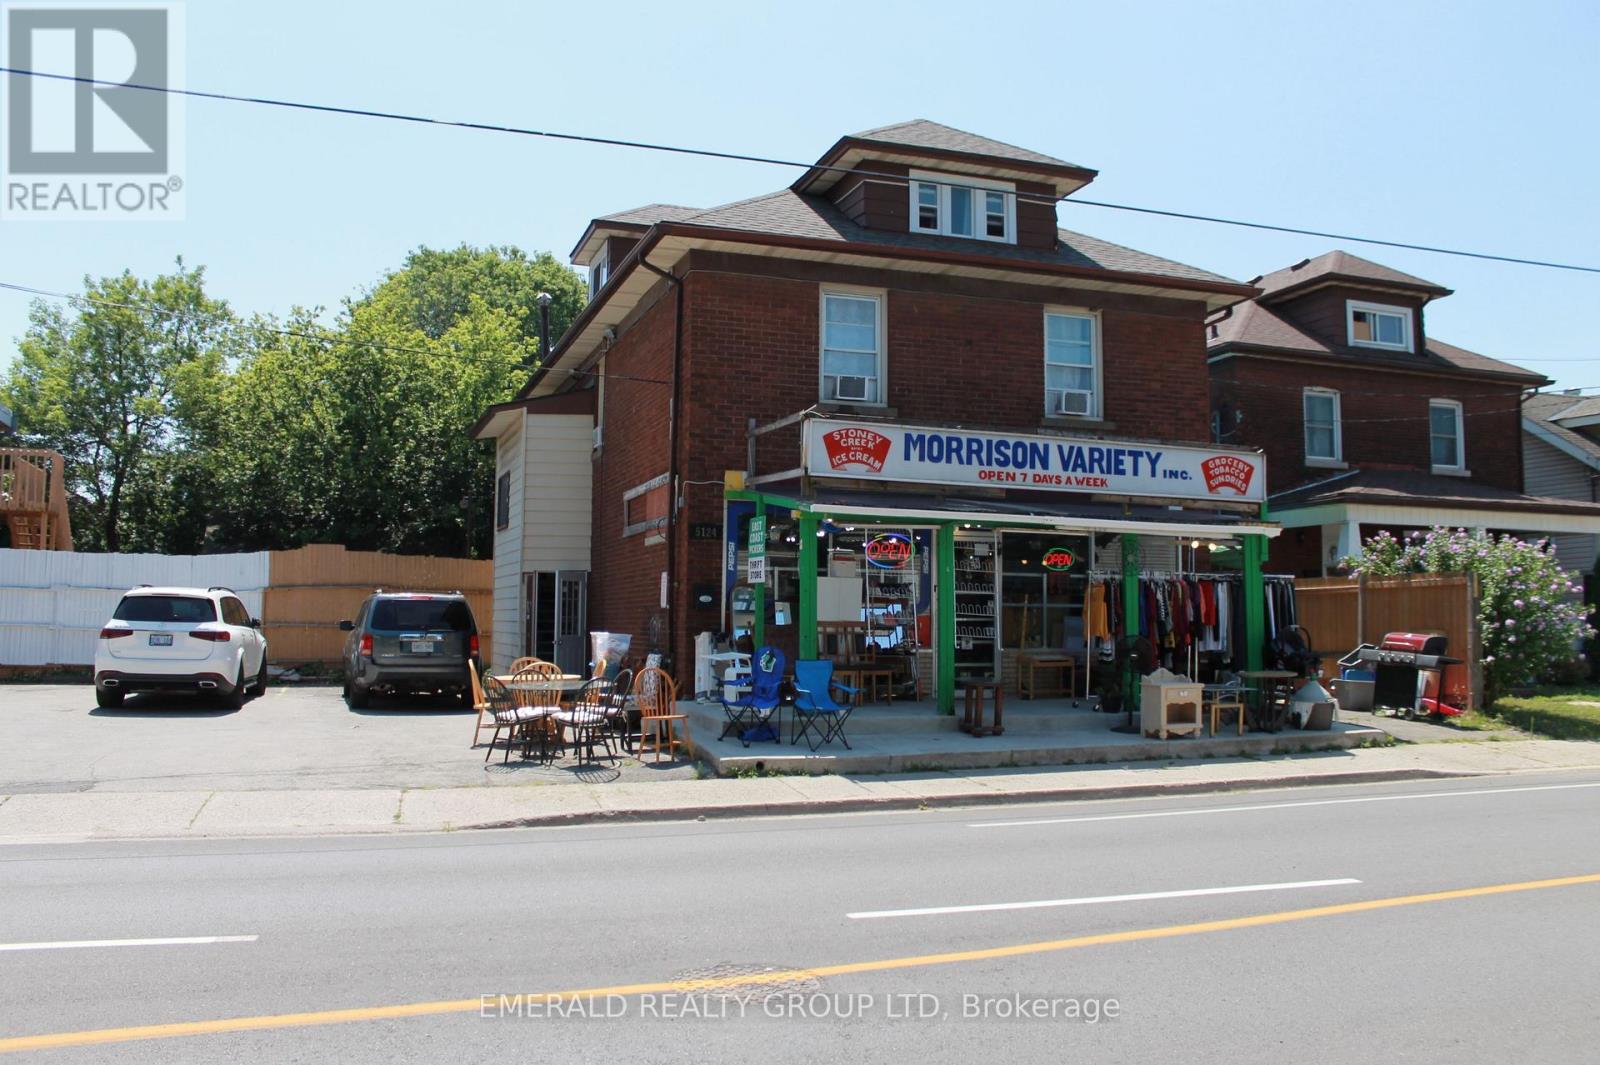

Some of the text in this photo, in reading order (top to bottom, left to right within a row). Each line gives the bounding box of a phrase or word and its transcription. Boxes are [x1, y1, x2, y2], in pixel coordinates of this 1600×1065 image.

[832, 429, 883, 444] STONEY
[840, 438, 875, 449] CREEK
[831, 451, 882, 470] ICE CREAM
[903, 432, 1192, 480] MORRISON VARIETY INC.
[1208, 457, 1250, 473] GROCERY
[1209, 465, 1246, 480] TOBACCO
[978, 470, 1109, 488] OPEN 7 DAYS A WEEK
[1210, 475, 1247, 492] SUNDRIES
[750, 531, 763, 543] COAST
[869, 542, 912, 560] OPEN
[1045, 553, 1073, 566] OPEN
[750, 570, 762, 580] STORE
